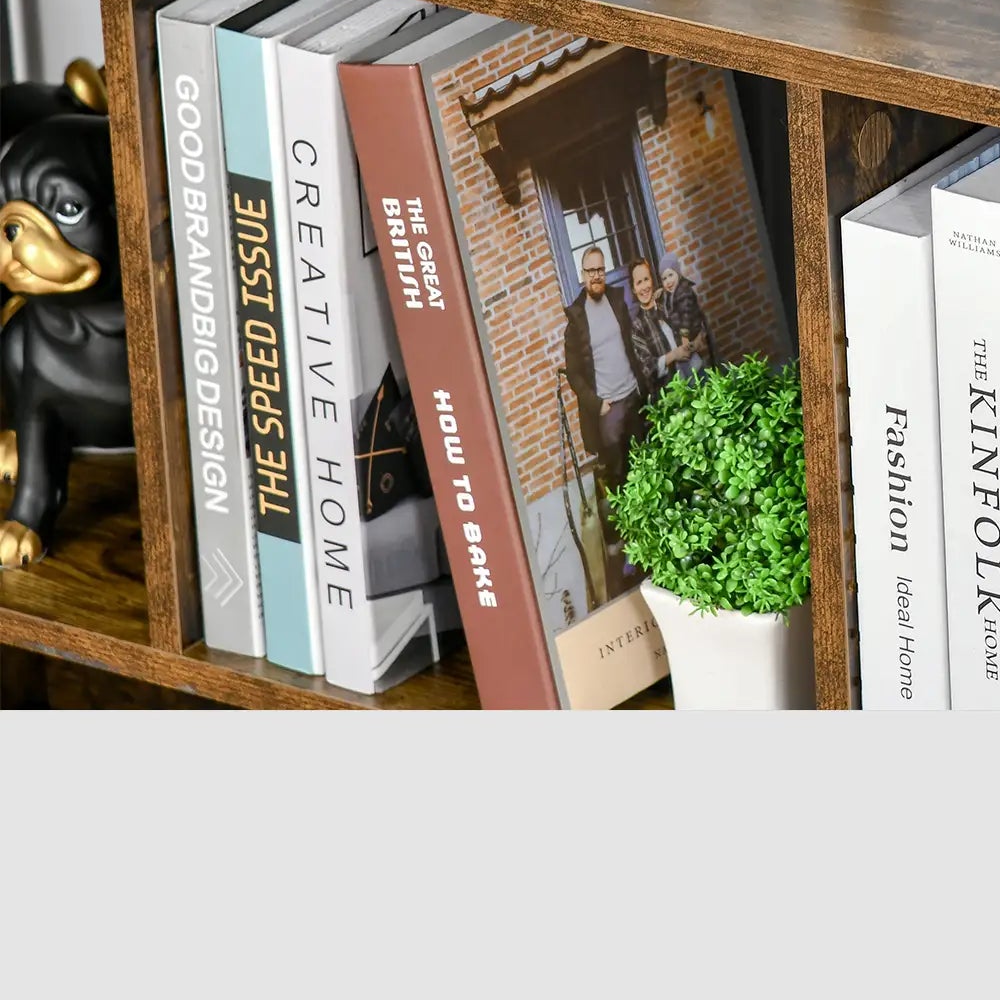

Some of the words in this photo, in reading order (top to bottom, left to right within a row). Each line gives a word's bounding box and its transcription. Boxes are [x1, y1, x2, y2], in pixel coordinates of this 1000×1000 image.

[234, 192, 275, 313] ISSUE
[405, 196, 429, 236] THE
[948, 238, 1000, 257] WILLIAMS
[952, 230, 996, 247] NATHAN
[382, 197, 424, 310] BRITISH
[416, 241, 446, 311] GREAT
[244, 319, 285, 440] SPEED
[292, 139, 338, 423] CREATIVE
[316, 456, 354, 610] HOME
[432, 389, 466, 465] HOW
[254, 443, 291, 515] THE
[452, 474, 476, 512] TO
[885, 403, 913, 553] Fashion
[973, 338, 988, 381] THE
[983, 618, 999, 681] HOME
[462, 521, 498, 608] BAKE
[896, 575, 915, 630] Ideal
[898, 634, 914, 700] Home
